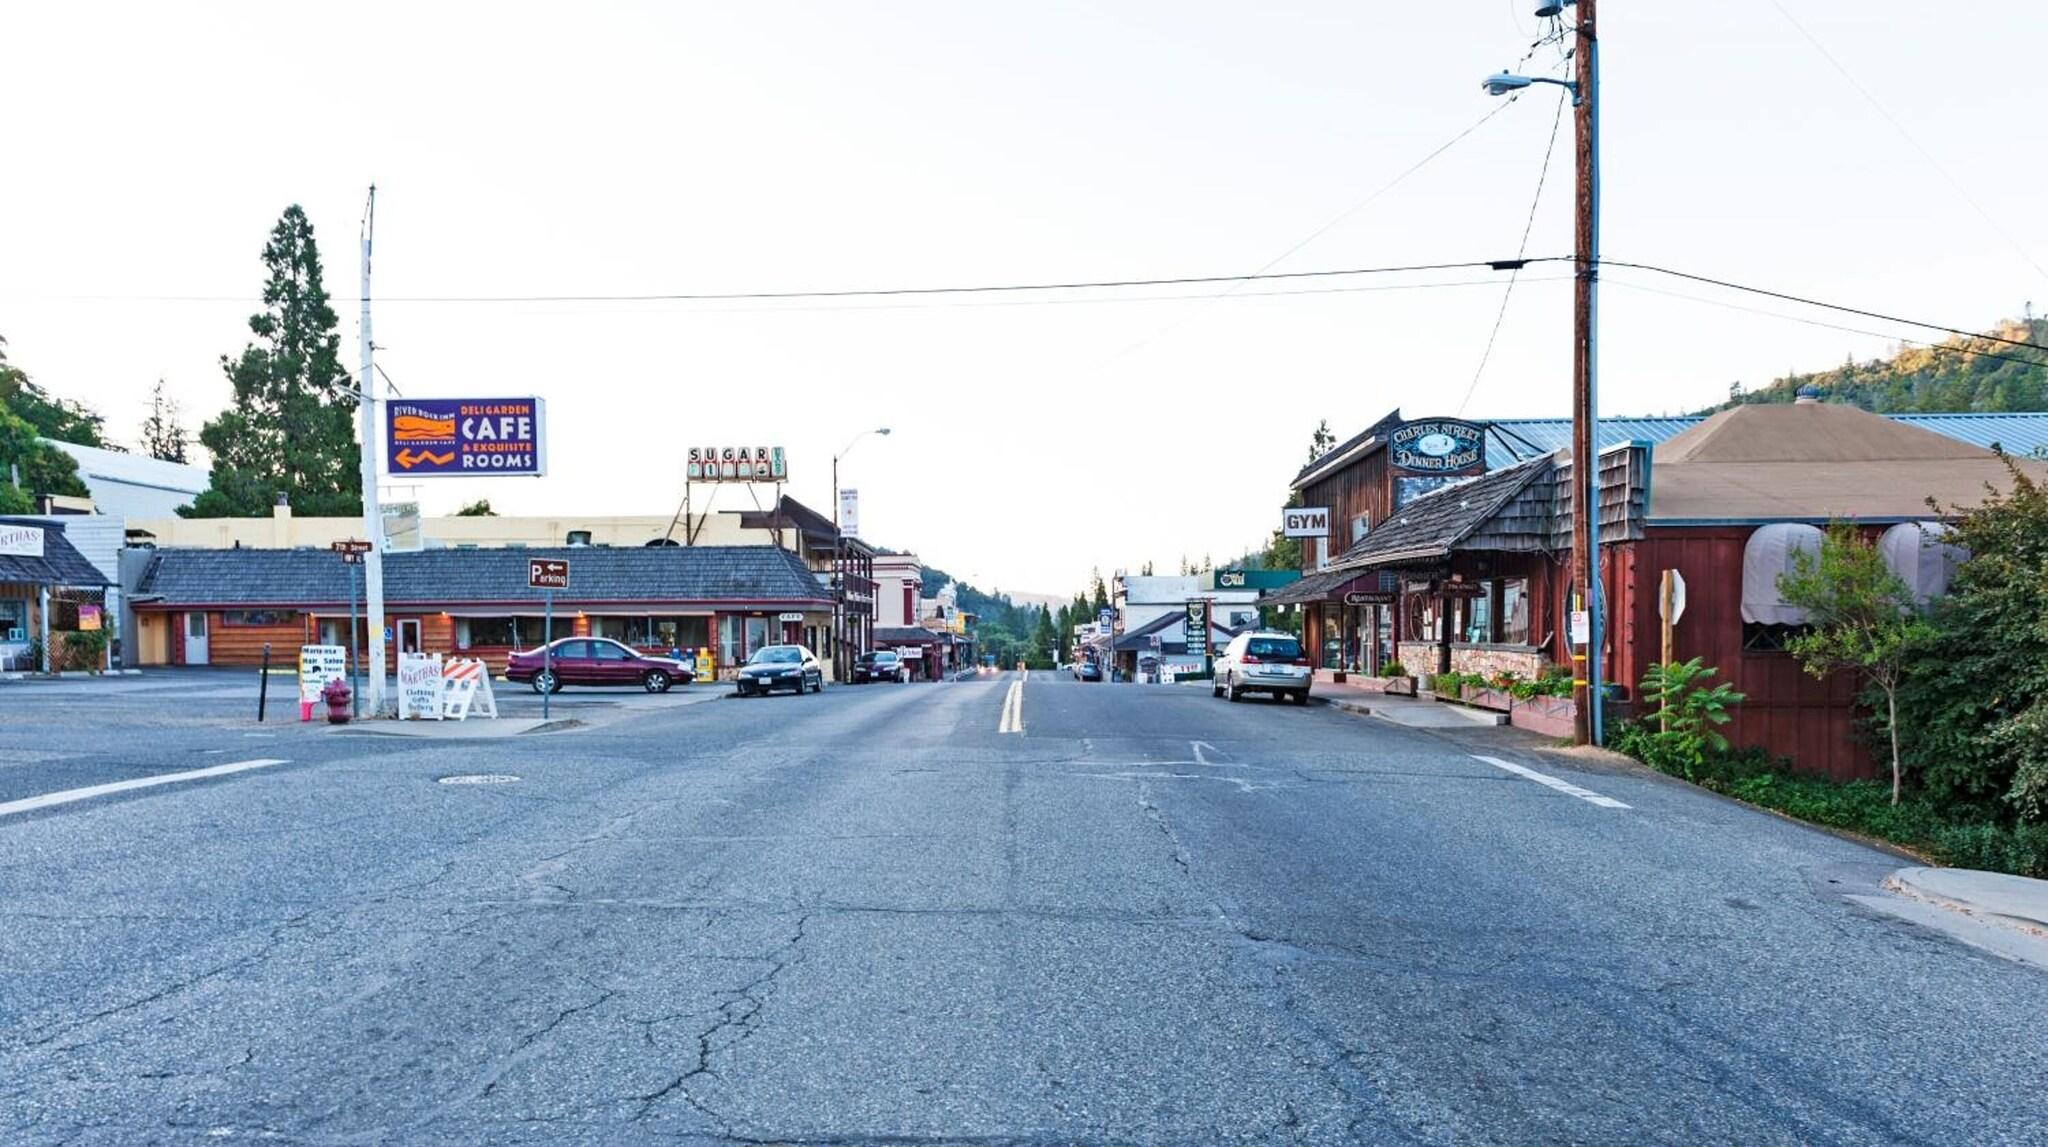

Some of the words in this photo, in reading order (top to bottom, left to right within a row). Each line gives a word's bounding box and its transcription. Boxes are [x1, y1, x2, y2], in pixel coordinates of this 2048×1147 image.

[394, 406, 416, 417] RIVER
[418, 409, 438, 420] ROCK
[461, 406, 484, 415] DELI
[486, 406, 529, 414] GARDEN
[462, 417, 531, 440] CAFE
[1393, 423, 1439, 443] CHARLES
[1441, 424, 1480, 441] STREET
[462, 443, 471, 451] &
[473, 443, 532, 452] EXQUISITE
[690, 449, 765, 461] SUGAR
[462, 454, 532, 468] ROOMS
[1396, 450, 1442, 469] DINNER
[1443, 449, 1478, 470] HOUSE
[1287, 513, 1326, 529] GYM
[532, 565, 566, 587] Parking
